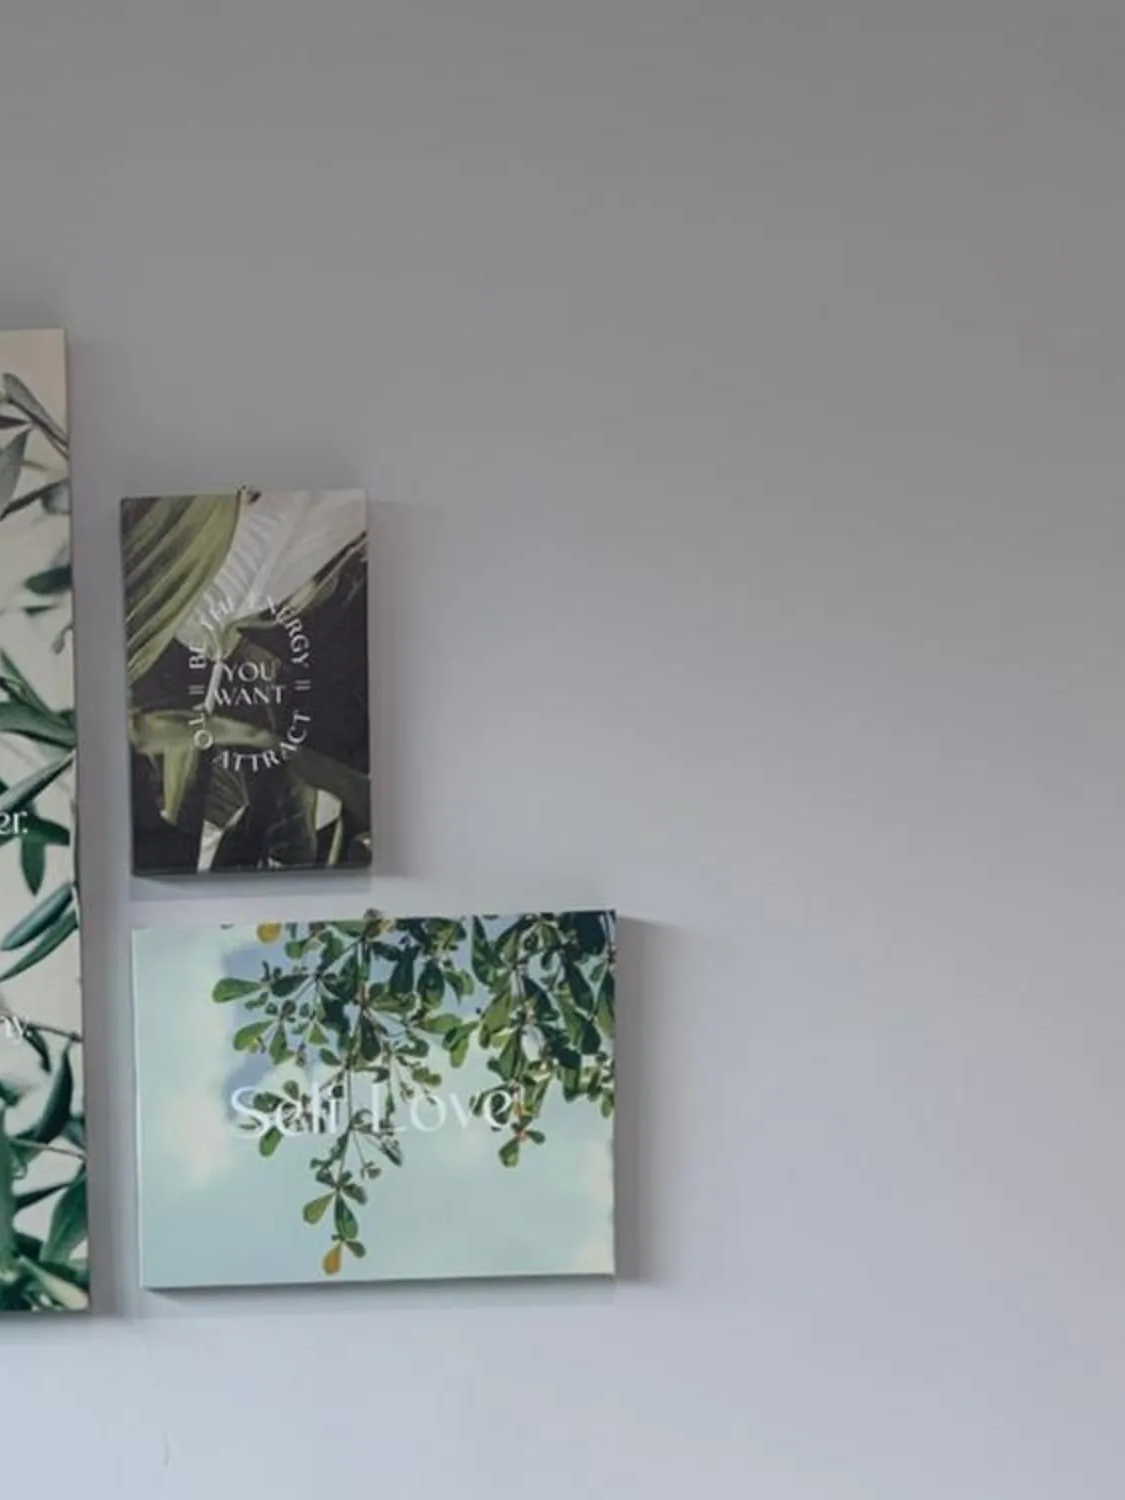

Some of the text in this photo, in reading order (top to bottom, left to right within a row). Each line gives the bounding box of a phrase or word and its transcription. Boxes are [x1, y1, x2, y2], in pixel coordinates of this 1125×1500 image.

[221, 662, 275, 684] YOU
[213, 684, 285, 706] WANT
[188, 711, 214, 750] TO
[212, 709, 311, 773] ATTRACT
[372, 1084, 516, 1133] Love
